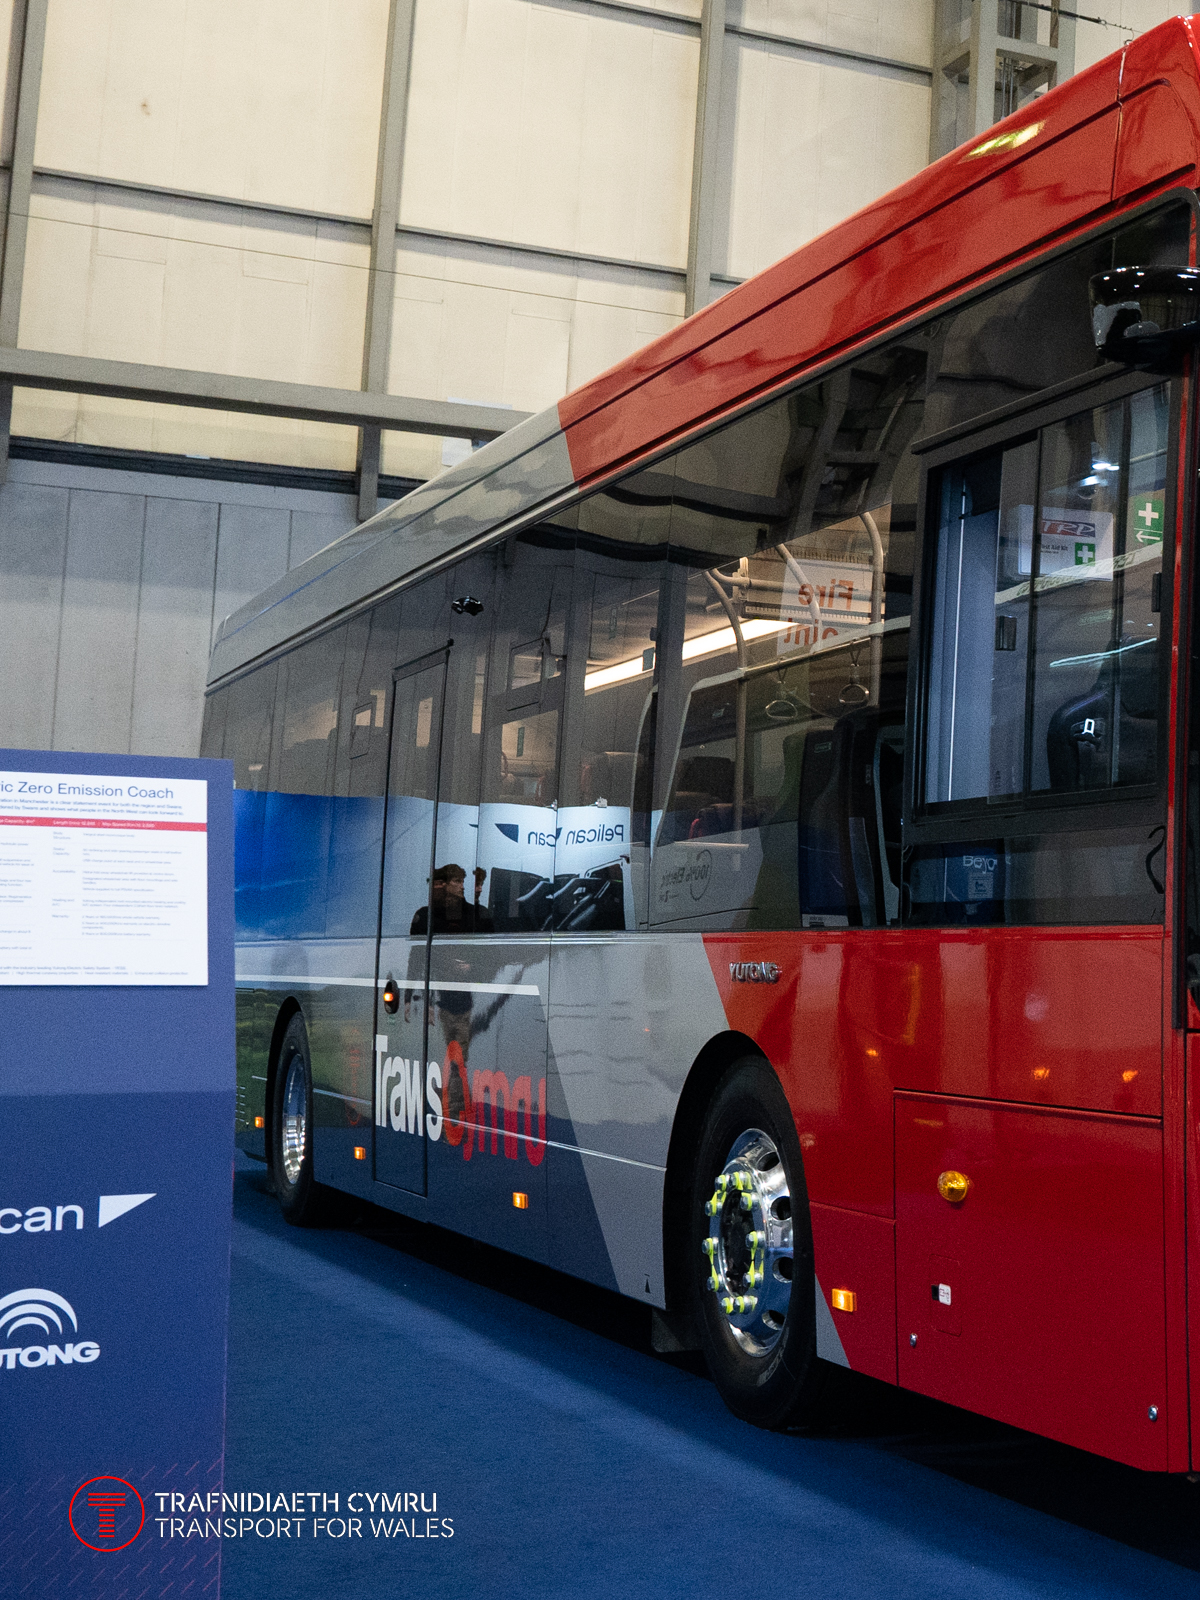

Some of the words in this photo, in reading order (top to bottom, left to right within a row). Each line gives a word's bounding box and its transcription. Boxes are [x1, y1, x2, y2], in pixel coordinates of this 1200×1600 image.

[0, 780, 14, 793] ic
[18, 781, 53, 795] Zero
[58, 783, 123, 797] Emission
[127, 785, 174, 799] Coach
[729, 962, 779, 984] YUTONG
[375, 1034, 547, 1167] TrawsCymru
